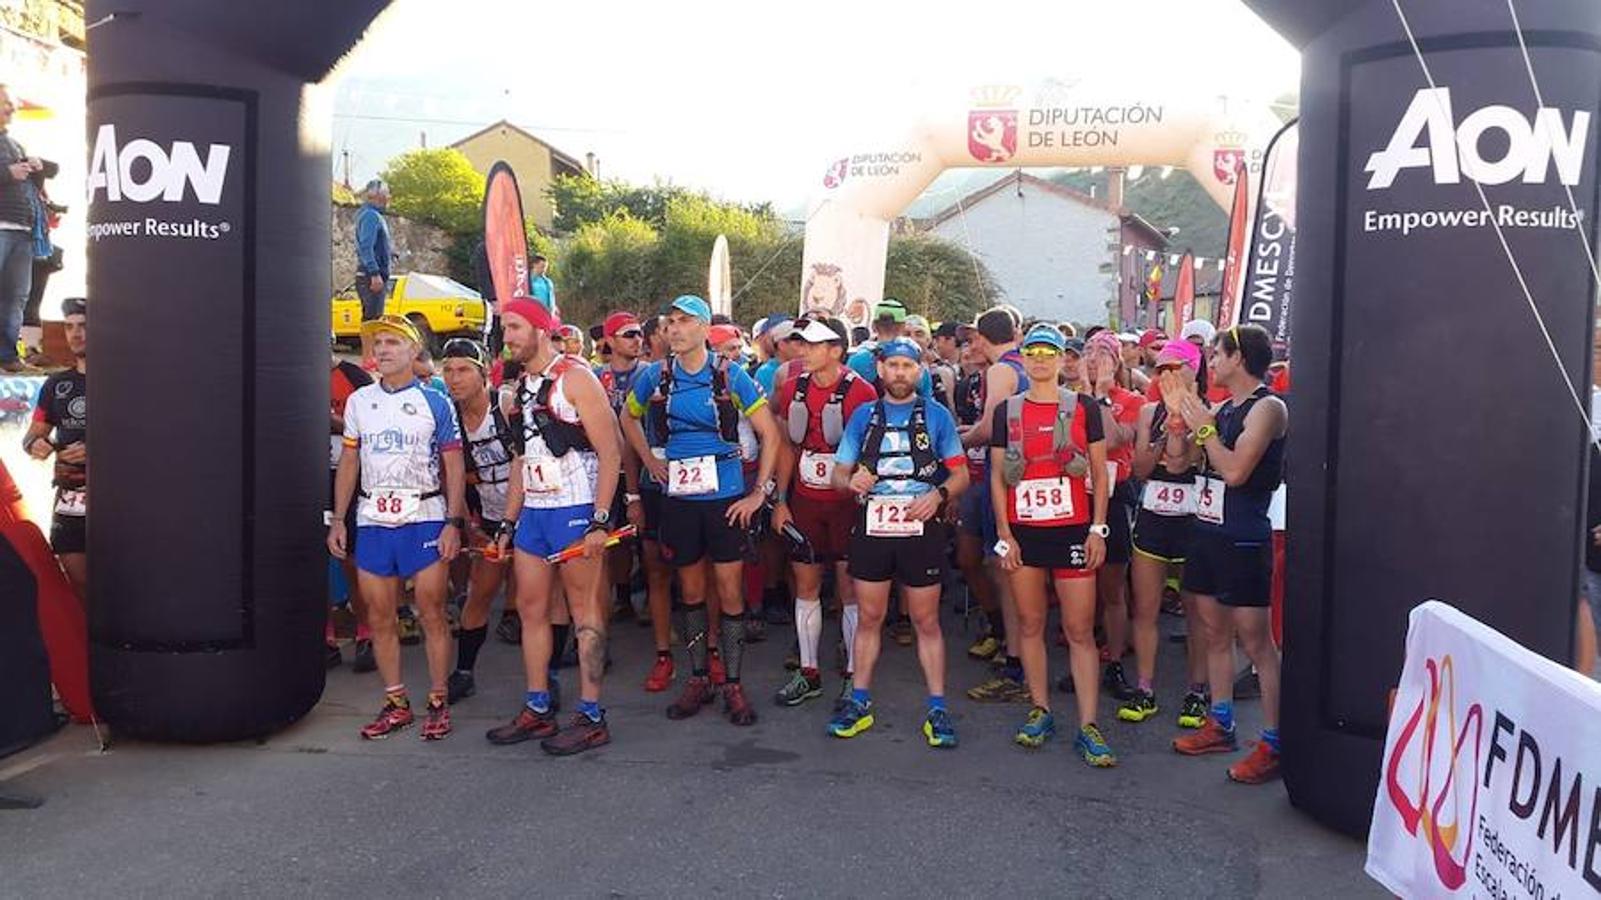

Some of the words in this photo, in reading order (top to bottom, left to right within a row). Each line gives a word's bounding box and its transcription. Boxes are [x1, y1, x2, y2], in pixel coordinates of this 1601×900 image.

[1029, 101, 1163, 126] DIPUTACIÓN
[1028, 131, 1054, 148] DE
[1061, 126, 1118, 147] LEÓN
[851, 166, 864, 177] DE
[867, 163, 900, 177] LEÓN
[1364, 210, 1491, 236] Empower
[678, 467, 704, 484] 22
[816, 462, 826, 477] 8
[1022, 489, 1062, 508] 158
[1157, 487, 1184, 504] 49
[376, 497, 402, 513] 88
